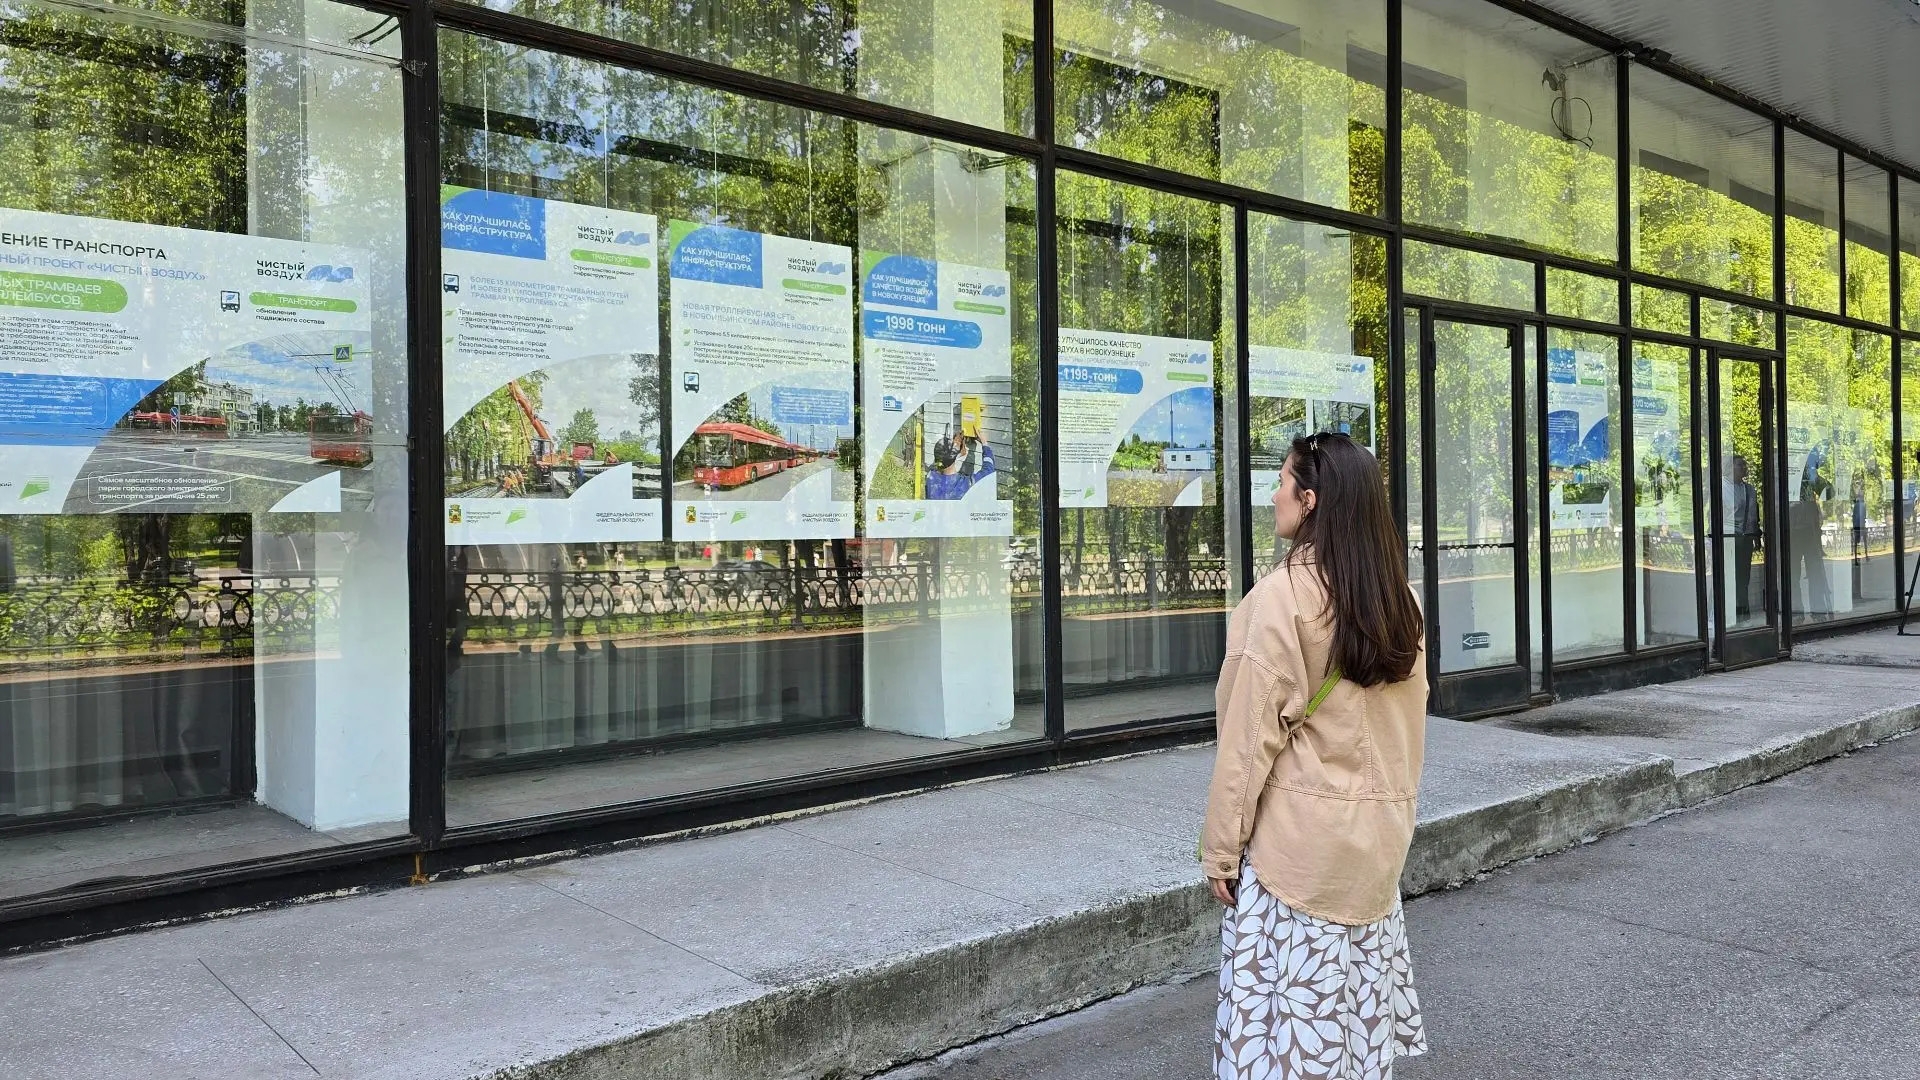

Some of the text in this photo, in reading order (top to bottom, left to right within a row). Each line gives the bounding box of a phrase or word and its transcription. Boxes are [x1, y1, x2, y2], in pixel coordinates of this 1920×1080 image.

[442, 211, 531, 231] КАК УЛУЧШИЛАСЬ
[442, 221, 533, 241] ИНФРАСТРУКТУРА
[2, 232, 167, 260] ЕНИЕ ТРАНСПОРТА
[681, 246, 751, 262] КАК УЛУЧШИЛАСЬ
[34, 256, 84, 269] ПРОЕКТ
[152, 268, 207, 280] ВОЗДУХ»
[681, 255, 753, 271] ИНФРАСТРУКТУРА
[470, 276, 496, 285] БОЛЕЕ
[871, 281, 905, 292] КАЧЕСТВО
[27, 279, 101, 295] ТРАМВАЕВ
[478, 285, 503, 293] БОЛЕЕ
[278, 296, 327, 307] ТРАНСПОРТ
[683, 302, 710, 311] НОВАЯ
[256, 308, 297, 316] обновление
[256, 315, 298, 323] подвижного
[1062, 336, 1142, 350] УЛУЧШИЛОСЬ КАЧЕСТВО
[1085, 348, 1136, 359] НОВОКУЗНЕЦКЕ
